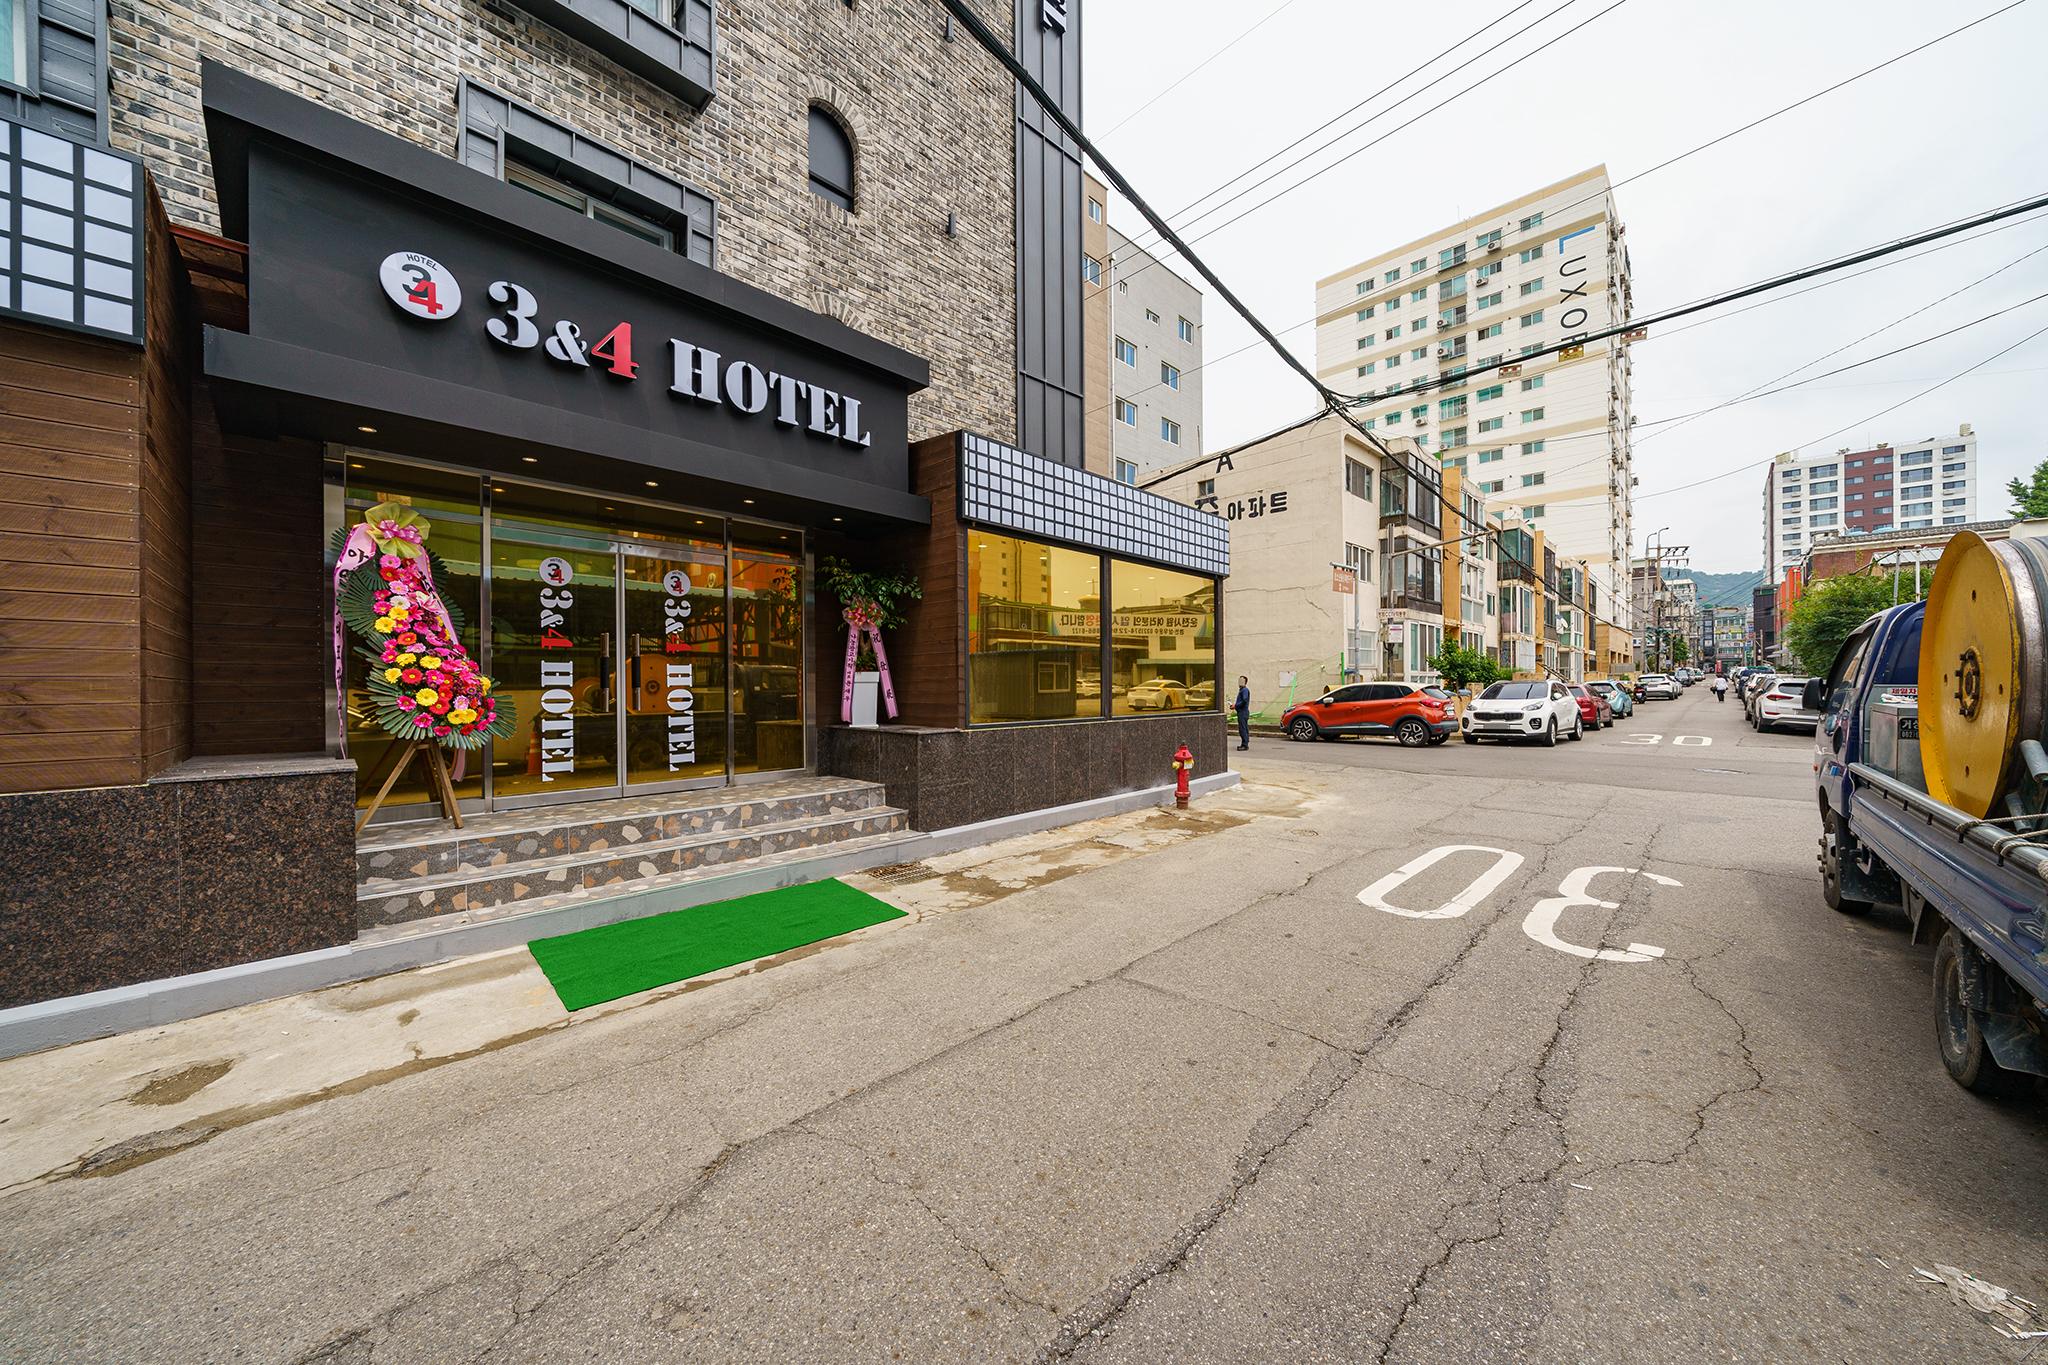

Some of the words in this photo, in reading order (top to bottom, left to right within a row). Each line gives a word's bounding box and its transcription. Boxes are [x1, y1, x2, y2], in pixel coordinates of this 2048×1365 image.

[406, 254, 438, 271] HOTEL
[485, 280, 640, 380] 3&4
[668, 338, 872, 448] HOTEL
[1216, 452, 1234, 474] A
[540, 588, 574, 650] 3&4
[664, 598, 693, 654] 3&4
[540, 660, 575, 782] HOTEL
[666, 663, 695, 772] HOTEL
[1620, 733, 1713, 747] 30
